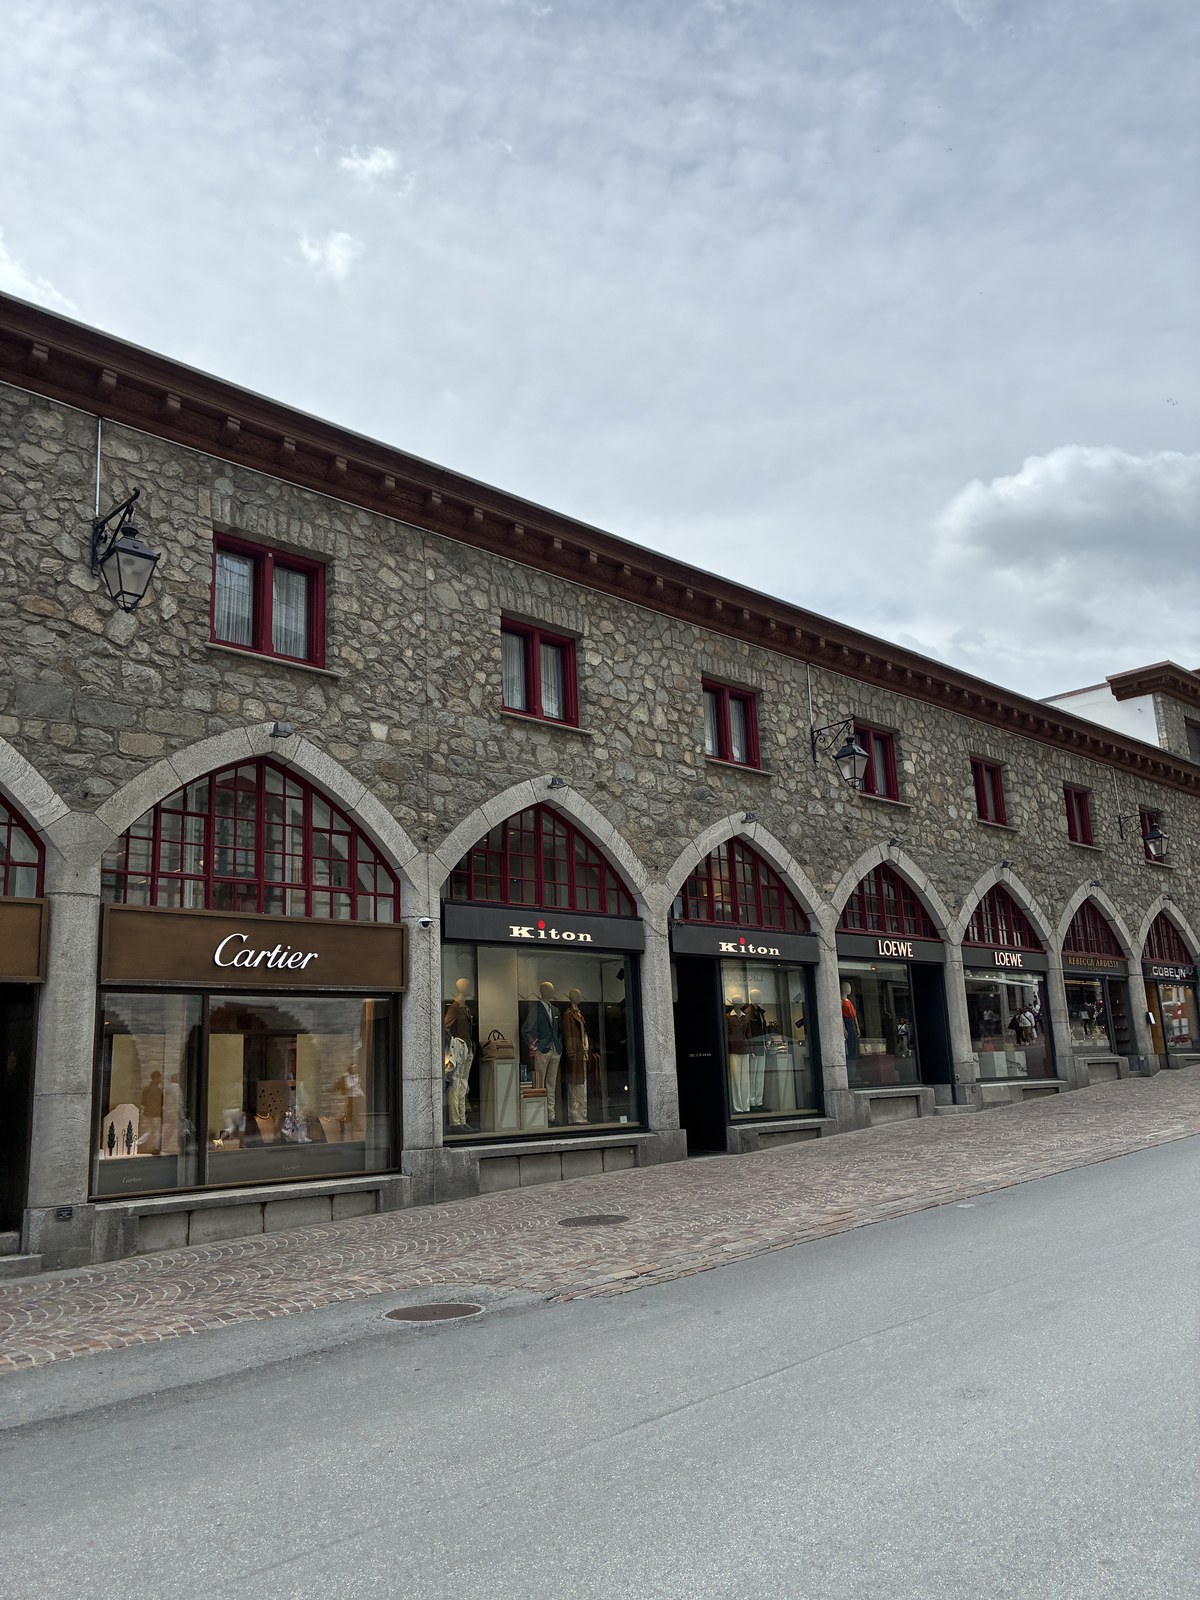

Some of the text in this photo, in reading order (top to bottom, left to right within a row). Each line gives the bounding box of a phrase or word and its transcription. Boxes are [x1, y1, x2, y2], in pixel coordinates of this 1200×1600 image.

[509, 920, 593, 942] Kiton
[214, 933, 318, 969] Cartier
[719, 936, 780, 955] Kiton
[878, 940, 914, 957] LOEWE
[994, 952, 1023, 967] LOEWE
